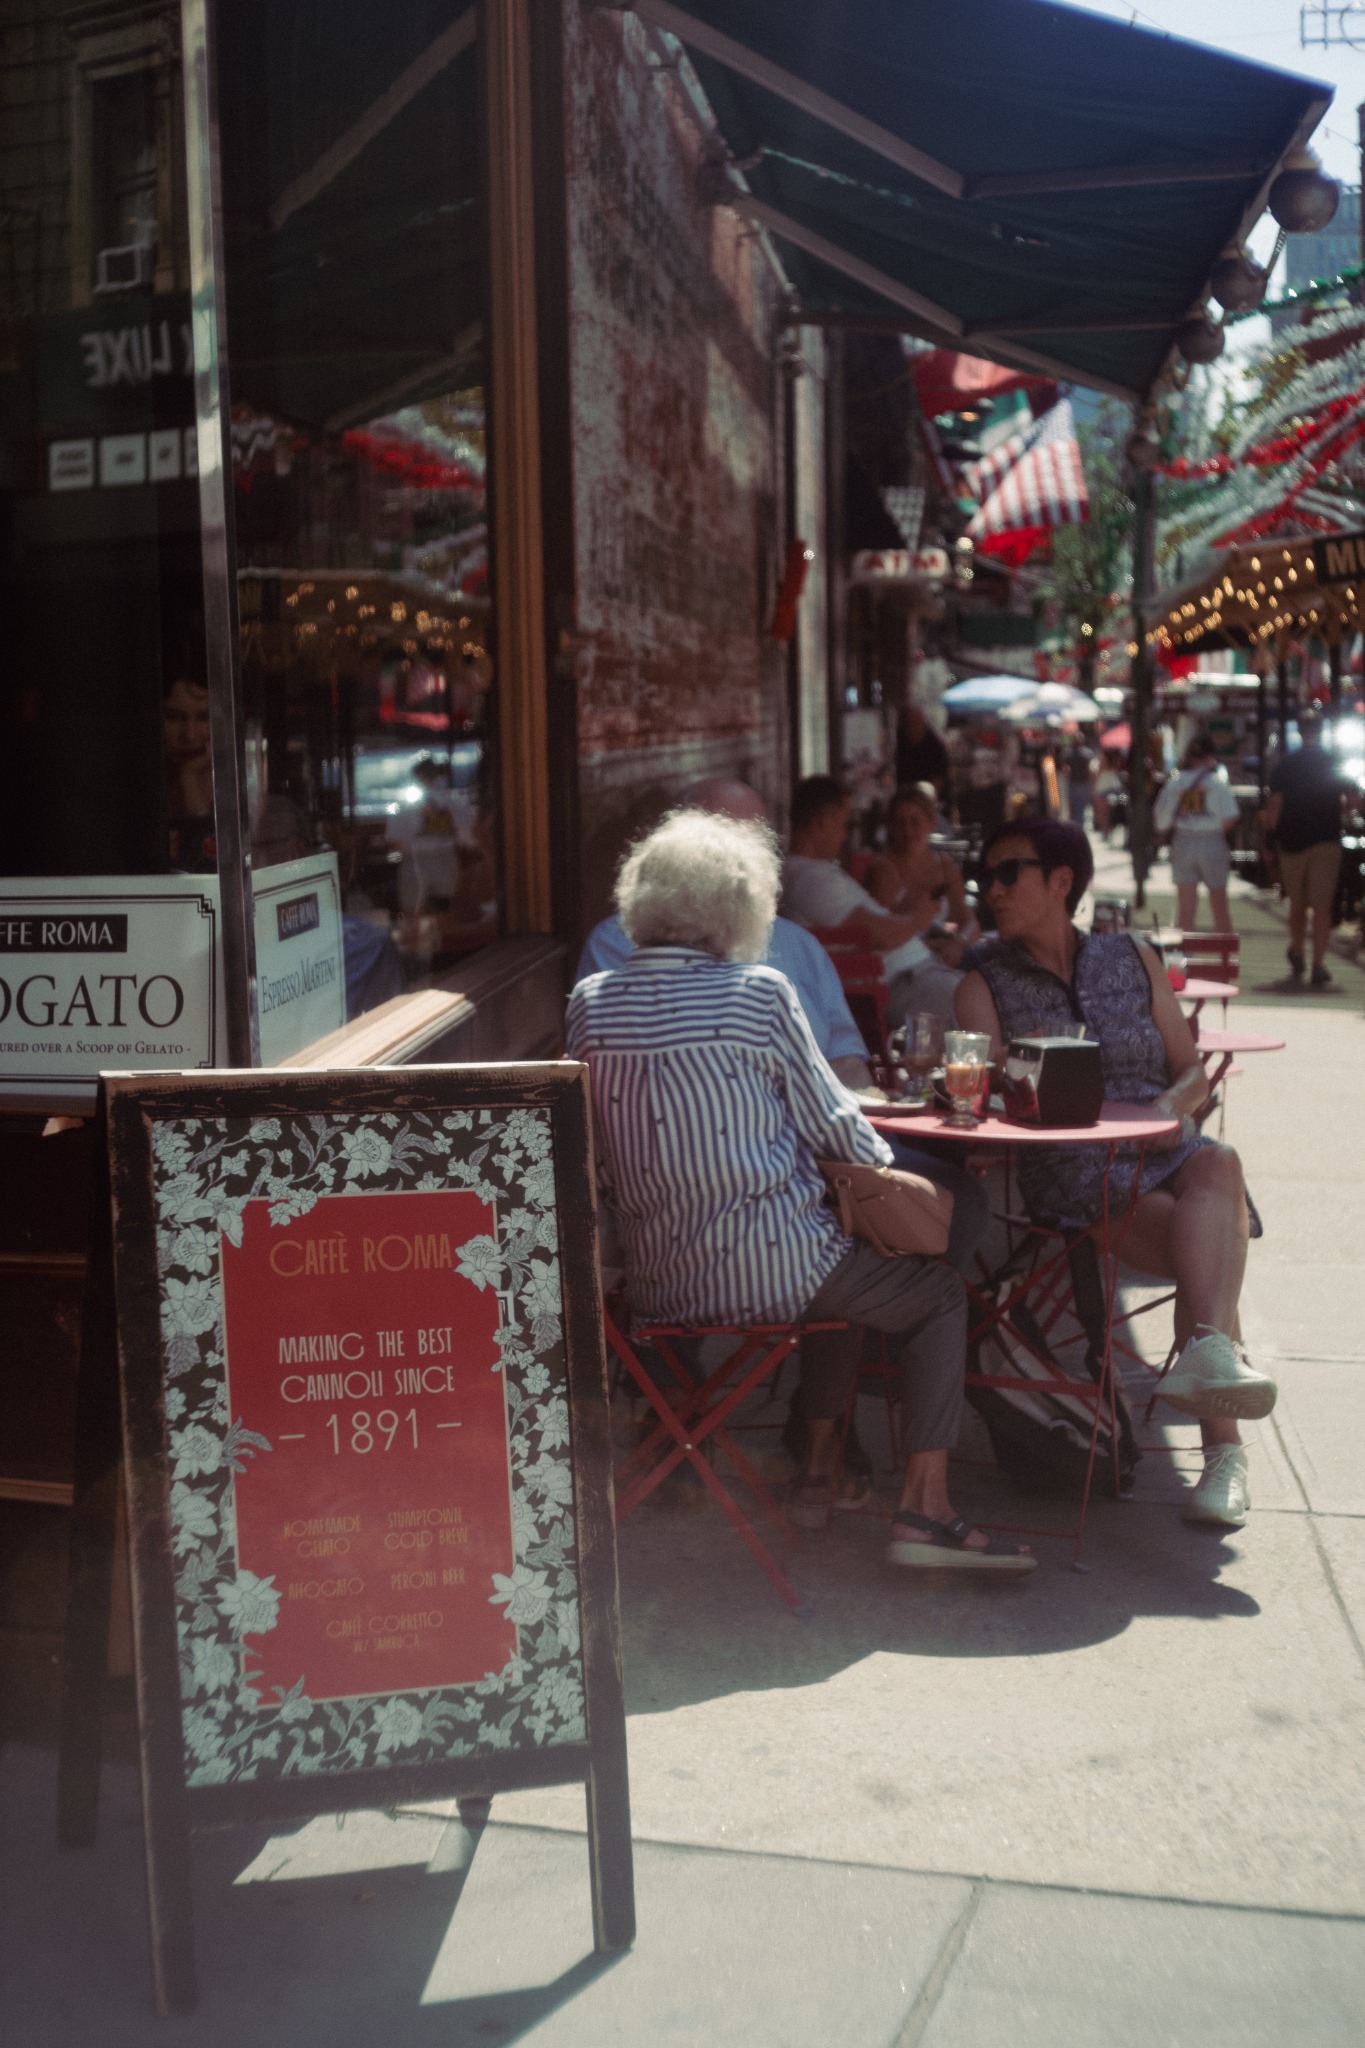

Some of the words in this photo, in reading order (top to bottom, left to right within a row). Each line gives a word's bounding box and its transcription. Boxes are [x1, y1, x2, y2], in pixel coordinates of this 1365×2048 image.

[42, 921, 113, 946] ROMA
[0, 974, 184, 1028] GATO
[31, 1042, 62, 1053] OVER
[269, 1231, 349, 1277] CAFFÈ
[363, 1233, 452, 1272] ROMA
[278, 1332, 364, 1364] MAKING
[376, 1330, 405, 1357] THE
[418, 1327, 452, 1355] BEST
[280, 1370, 382, 1403] CANNOLI
[395, 1365, 455, 1396] SINCE
[326, 1408, 418, 1455] 1891
[284, 1515, 361, 1538] HOMEMADE
[388, 1506, 462, 1529] STUMPTOWN
[297, 1537, 350, 1558] GELATO
[384, 1530, 433, 1550] COLD
[439, 1527, 468, 1545] BREW
[288, 1577, 365, 1600] AFFOGATO
[391, 1570, 437, 1591] PERONI
[442, 1567, 466, 1586] BEER
[368, 1610, 444, 1633] CORRETTO
